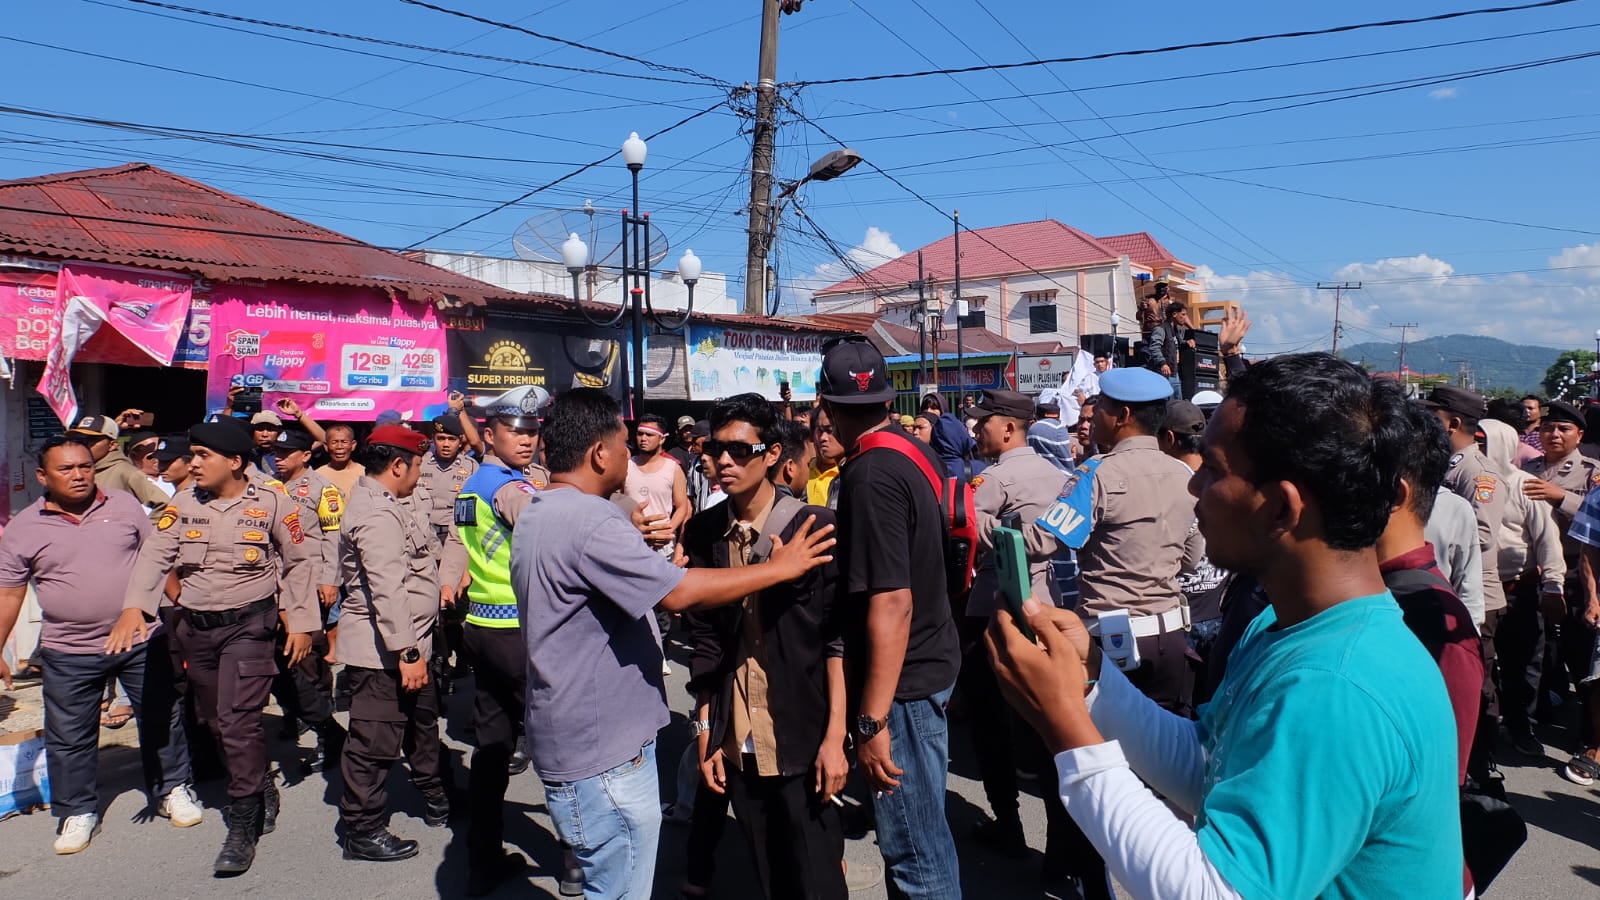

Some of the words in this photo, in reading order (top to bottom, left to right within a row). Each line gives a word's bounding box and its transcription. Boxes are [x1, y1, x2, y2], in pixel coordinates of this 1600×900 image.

[246, 304, 287, 319] Lebih
[237, 337, 259, 346] SPAM
[389, 336, 416, 348] Happy
[723, 331, 752, 348] TOKO
[755, 334, 785, 351] RIZKI
[236, 347, 258, 356] SCAM
[264, 354, 306, 368] Happy
[494, 352, 521, 367] 234
[246, 374, 264, 384] GB
[467, 374, 501, 385] SUPER
[503, 376, 545, 386] PREMIUM
[888, 370, 914, 391] RI
[1020, 373, 1033, 383] SMAN
[237, 518, 269, 530] POLRI
